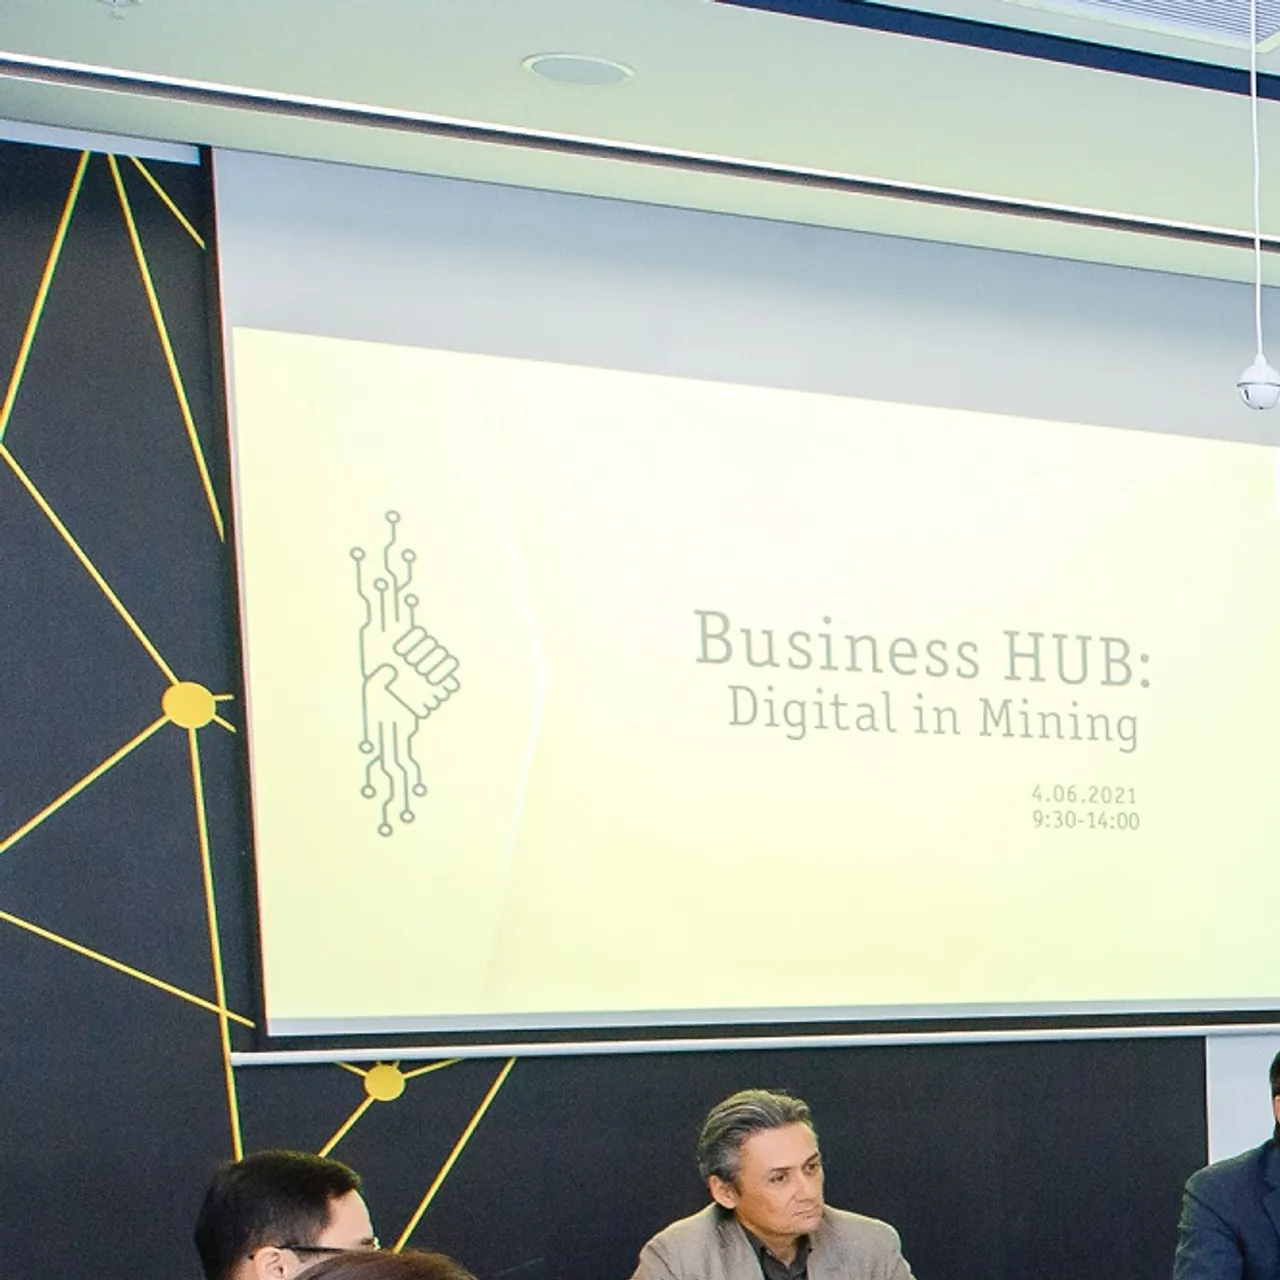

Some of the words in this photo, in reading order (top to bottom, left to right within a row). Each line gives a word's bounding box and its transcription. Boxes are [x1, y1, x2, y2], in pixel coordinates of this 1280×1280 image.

[693, 608, 981, 680] Business
[1003, 630, 1151, 690] HUB:
[727, 683, 898, 741] Digital
[912, 692, 961, 736] in
[979, 697, 1139, 754] Mining
[1031, 783, 1138, 806] 4.06.2021
[1032, 809, 1141, 831] 9:30-14:00
